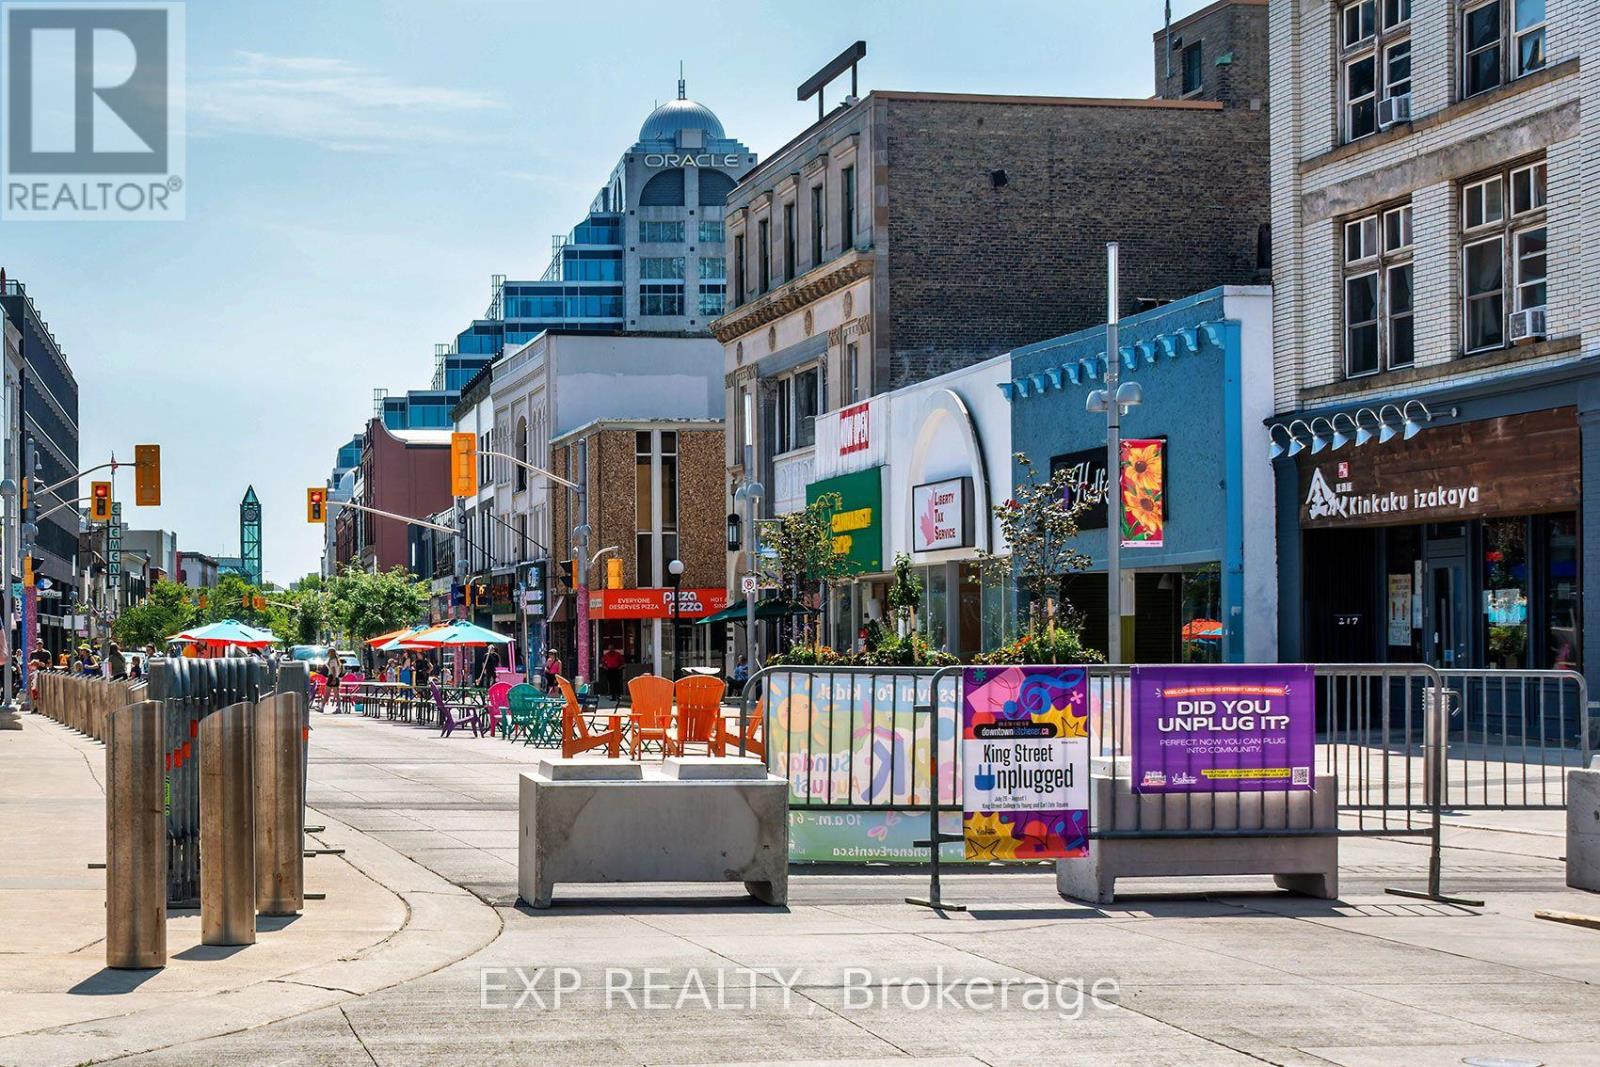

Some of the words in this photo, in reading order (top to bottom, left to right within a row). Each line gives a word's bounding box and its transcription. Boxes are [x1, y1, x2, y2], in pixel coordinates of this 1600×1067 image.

[644, 153, 739, 168] ORACLE
[1414, 486, 1479, 509] izakaya
[110, 504, 120, 585] ELEMENT
[668, 602, 704, 615] pzza
[1177, 701, 1217, 715] DID
[1222, 700, 1271, 714] YOU
[1158, 716, 1255, 732] UNPLUG
[1261, 715, 1290, 730] IT?
[983, 744, 1011, 767] King
[1015, 743, 1054, 763] Street
